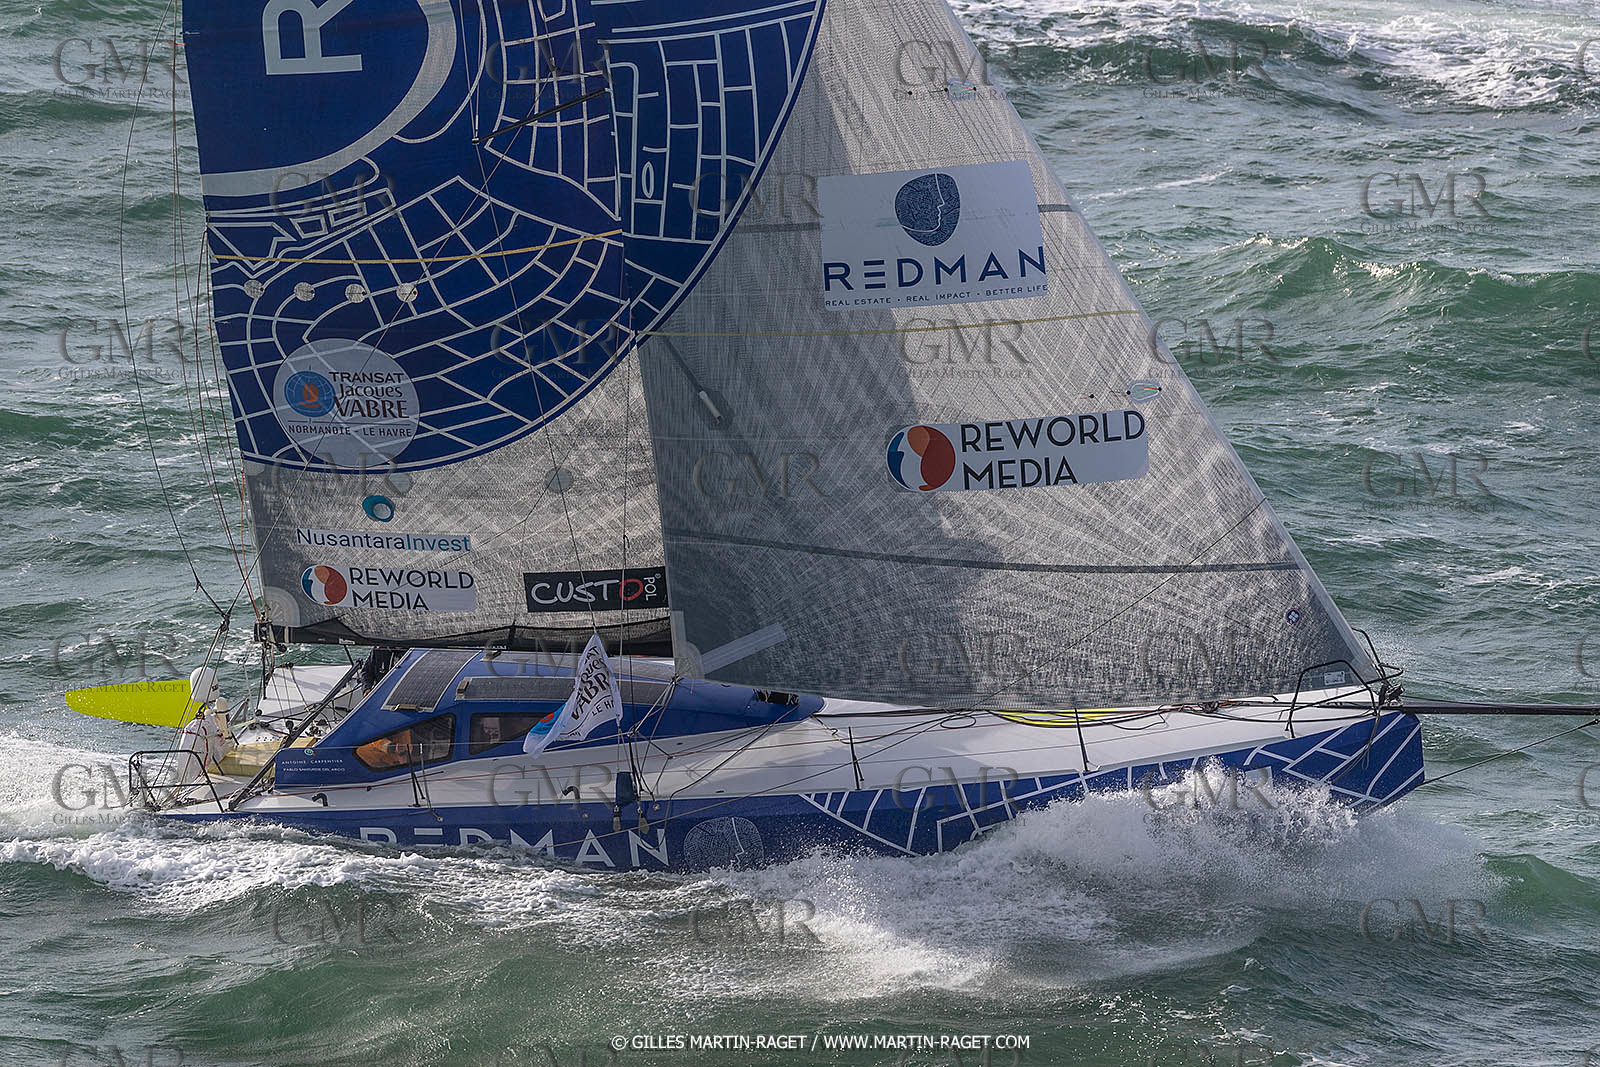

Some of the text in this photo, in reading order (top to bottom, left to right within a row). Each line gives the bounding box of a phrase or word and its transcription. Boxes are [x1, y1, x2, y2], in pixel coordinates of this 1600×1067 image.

[262, 0, 363, 75] R
[823, 246, 1046, 292] REDMAN
[825, 284, 1049, 307] REAL ESTATE REAL IMPACT BETTER LIFE
[329, 372, 404, 384] TRANSAT
[340, 383, 403, 399] Jacques
[333, 396, 410, 418] VABRE
[288, 425, 351, 436] NORMANDIE
[363, 428, 376, 436] LE
[380, 428, 412, 437] HAVRE
[960, 410, 1146, 453] REWORLD
[962, 455, 1079, 491] MEDIA
[296, 528, 471, 552] NusantaraInvest
[350, 567, 474, 590] REWORLD
[352, 590, 429, 611] MEDIA
[531, 576, 657, 605] CUSTO POL
[571, 672, 610, 720] VABR
